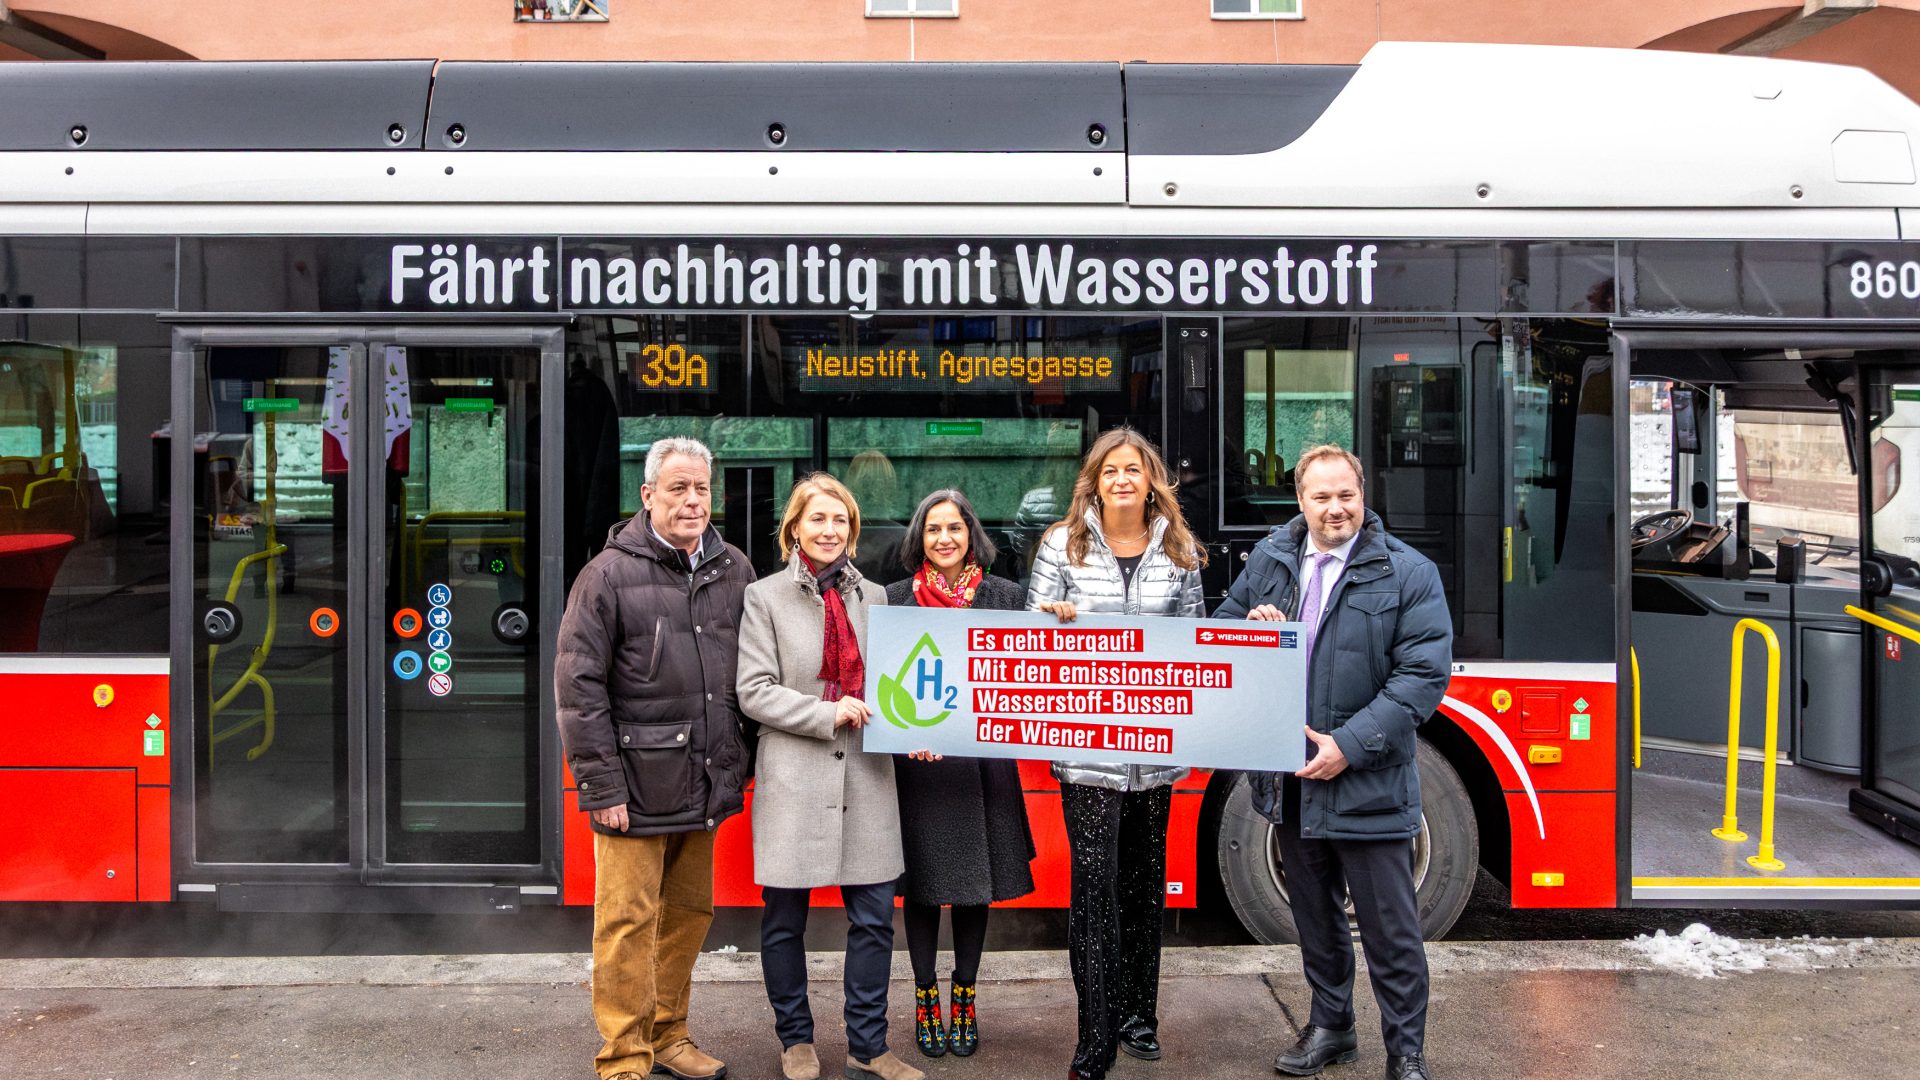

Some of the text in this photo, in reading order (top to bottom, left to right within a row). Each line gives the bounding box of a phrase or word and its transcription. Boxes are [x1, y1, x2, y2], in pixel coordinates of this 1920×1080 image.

[391, 243, 1379, 319] Fährt nachhaltig mit Wasserstoff
[1850, 260, 1920, 299] 860
[641, 344, 708, 388] 39A
[806, 349, 1113, 384] Neustift, Agnesgasse
[972, 629, 1136, 656] Es geht bergauf!
[1216, 633, 1249, 642] WIENER
[1249, 634, 1277, 643] LINIEN
[973, 658, 1227, 688] Mit den emissionsfreien
[976, 689, 1189, 714] Wasserstoff-Bussen
[979, 718, 1169, 753] der Wiener Linien
